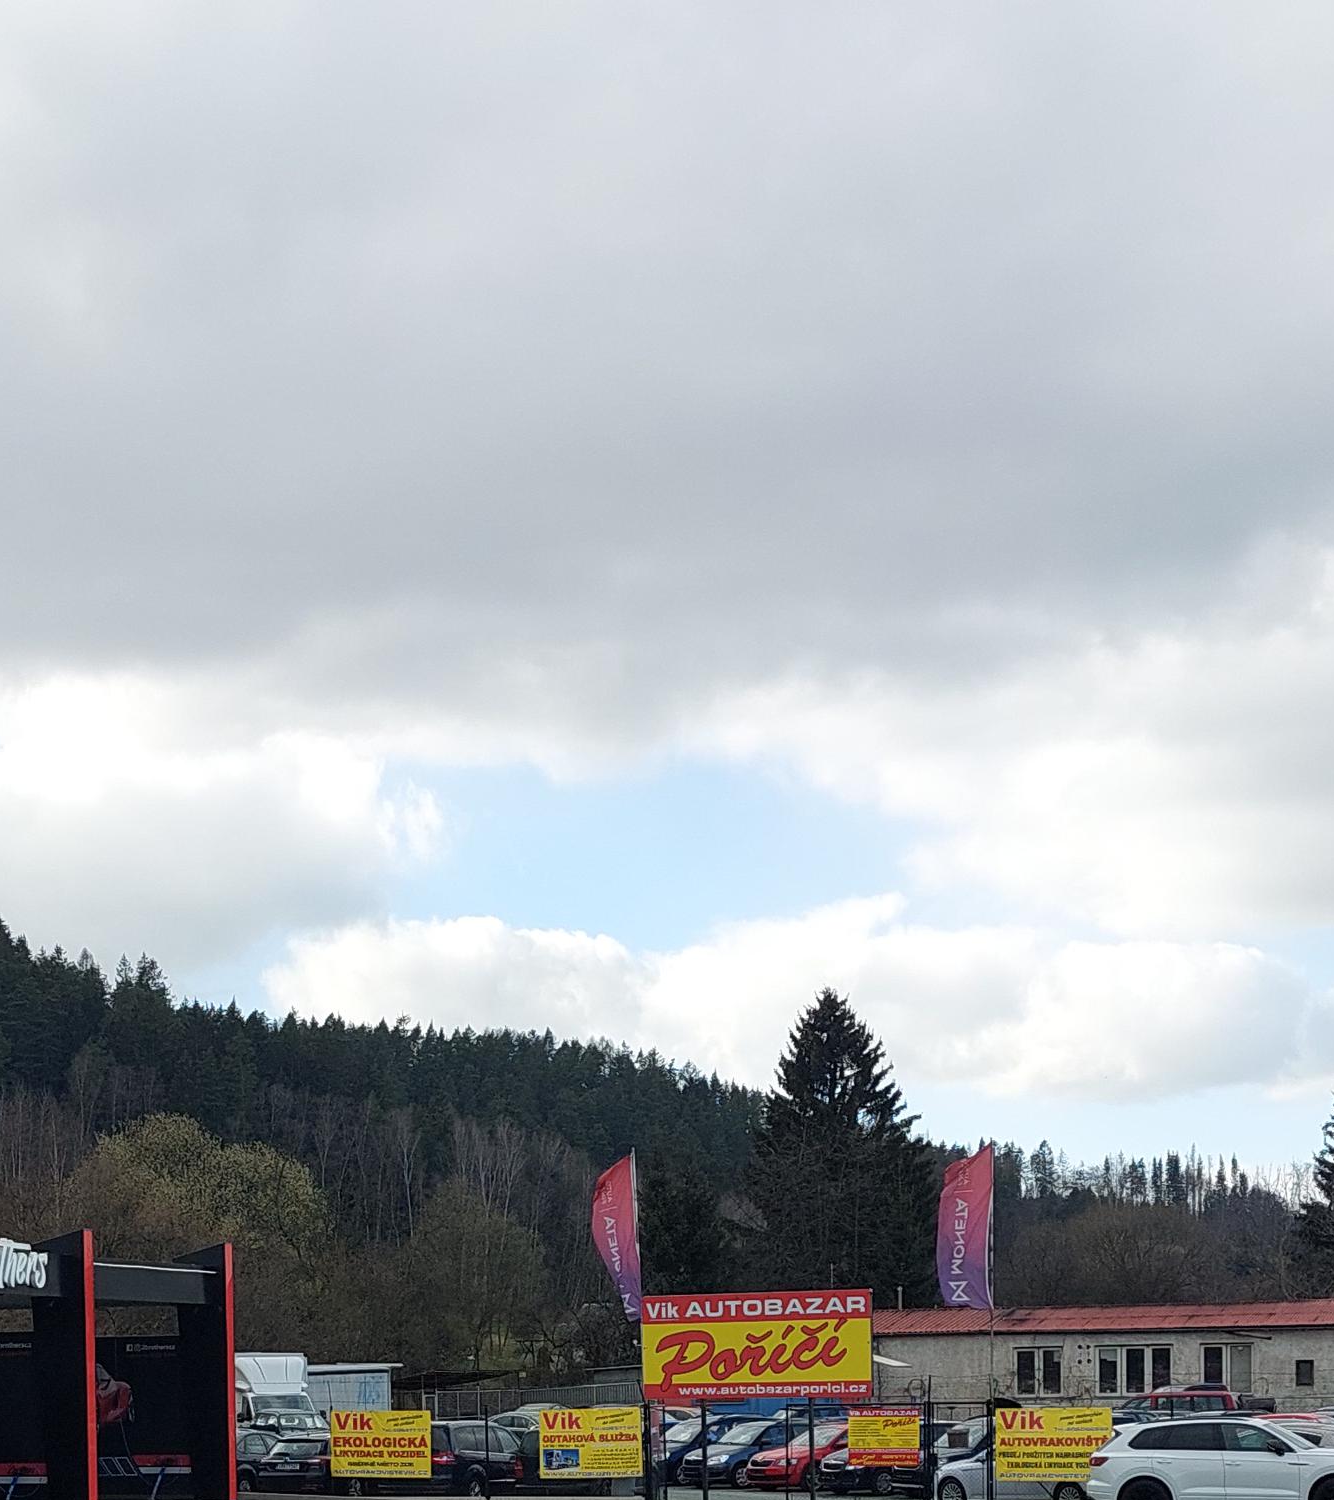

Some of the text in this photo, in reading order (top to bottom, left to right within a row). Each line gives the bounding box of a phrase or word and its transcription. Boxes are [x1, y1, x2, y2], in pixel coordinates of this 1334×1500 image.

[646, 1297, 866, 1318] Vik AUTOBAZAR
[656, 1318, 848, 1392] Poříčí
[679, 1384, 868, 1395] www.autobazarporici.cz
[334, 1413, 373, 1430] Vik
[542, 1412, 583, 1430] Vik
[1000, 1410, 1044, 1430] Vik
[333, 1435, 428, 1448] EKOLOGICKÁ
[542, 1432, 639, 1443] ODTAHOVÁ SLUŽBA
[334, 1450, 428, 1458] LIKVIDACE VOZIDEL
